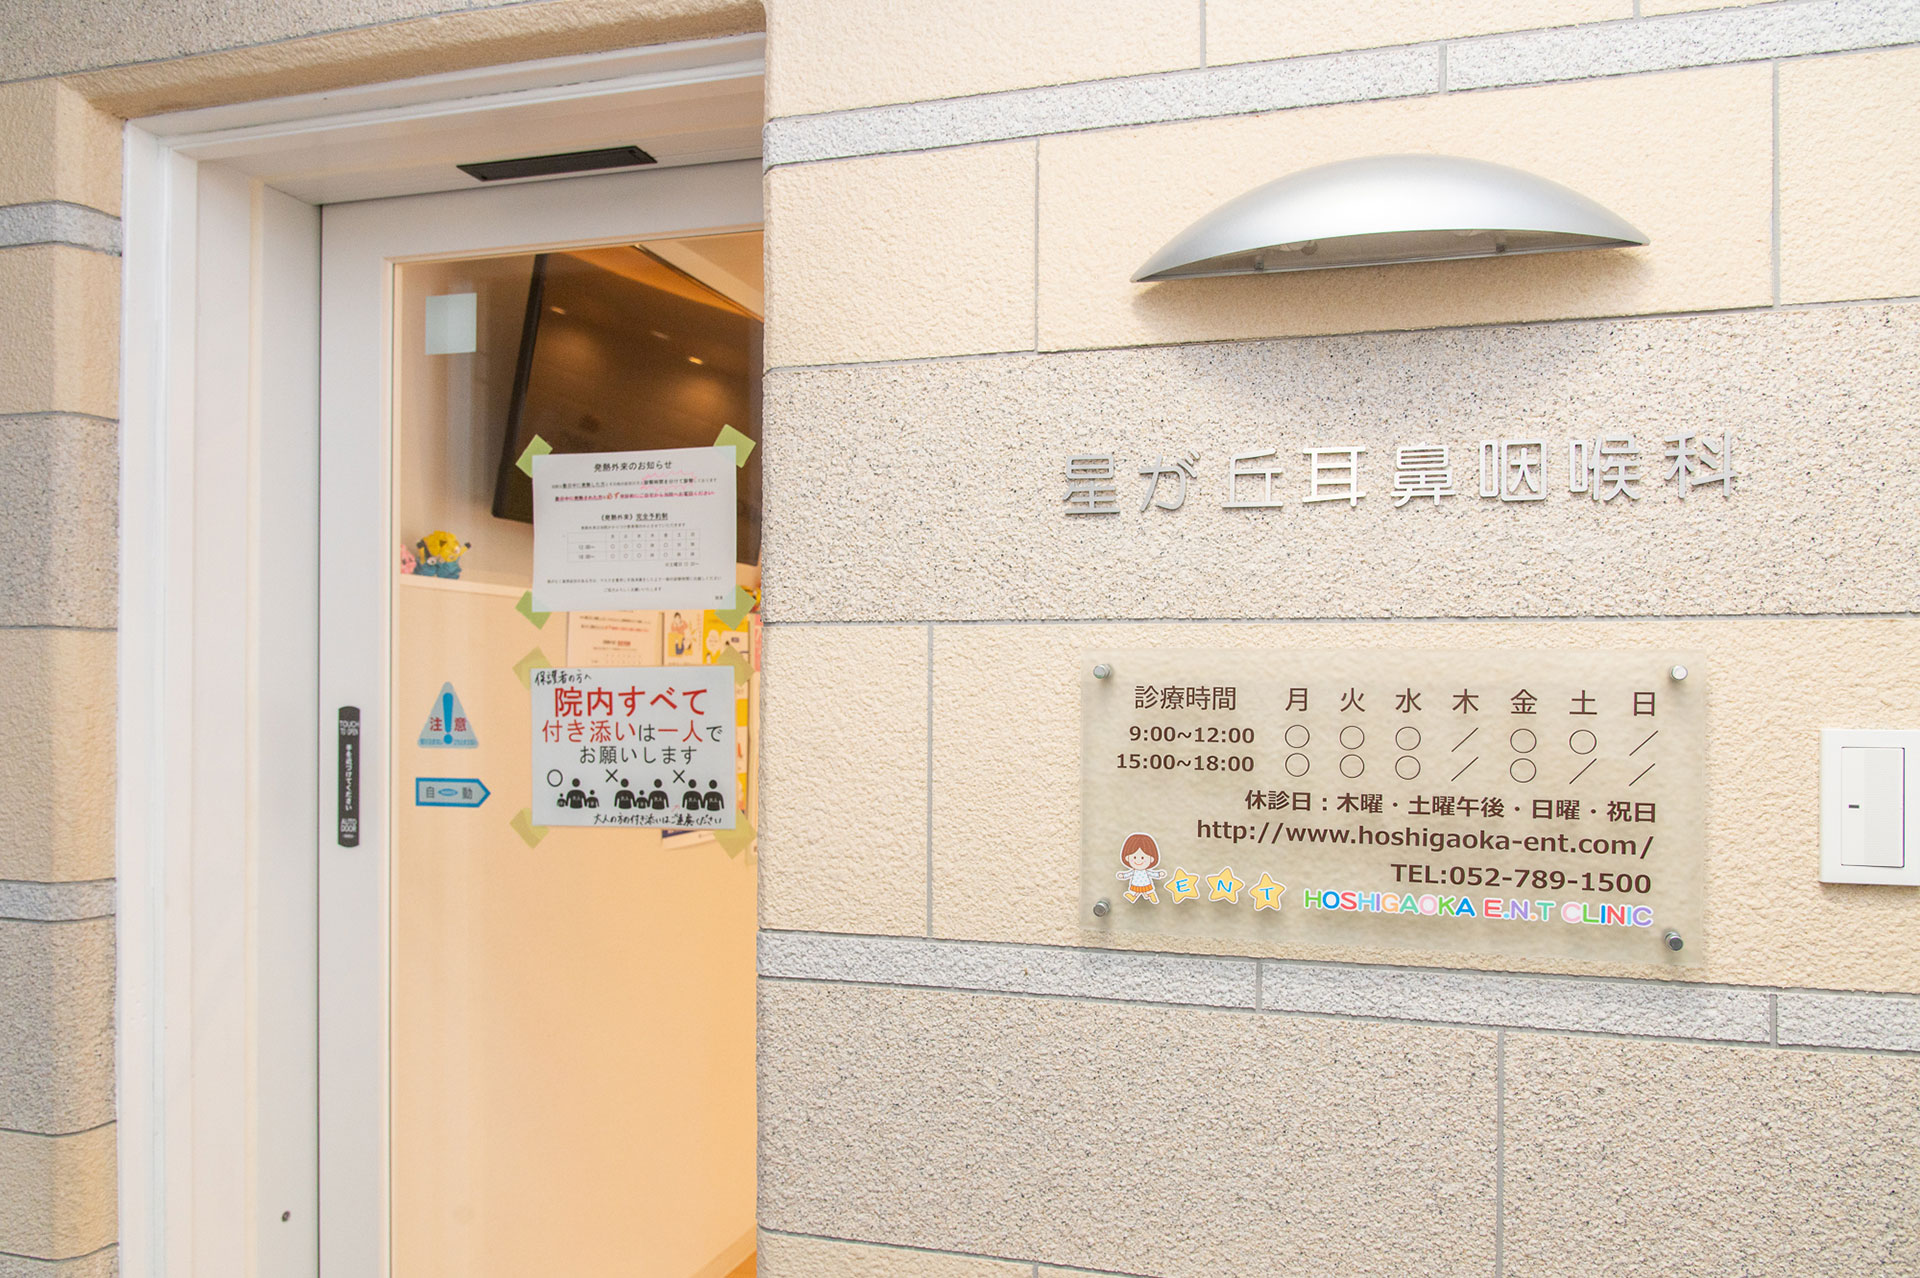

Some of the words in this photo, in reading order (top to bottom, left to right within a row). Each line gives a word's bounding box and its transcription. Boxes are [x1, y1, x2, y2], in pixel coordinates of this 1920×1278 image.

[593, 460, 672, 472] 発熱外来のお知らせ
[1063, 430, 1739, 515] 星が丘耳鼻咽喉科
[534, 670, 591, 686] 保護者の方へ
[555, 686, 708, 718] 院内すべて
[1135, 685, 1237, 711] 診療時間
[1285, 687, 1308, 712] 月
[1340, 688, 1365, 713] 火
[1395, 688, 1422, 713] 水
[1452, 688, 1479, 714] 木
[1510, 689, 1538, 715] 金
[1569, 690, 1597, 715] 土
[1633, 691, 1655, 716] 日
[542, 719, 723, 743] 付き添いは一人で
[579, 745, 698, 765] お願いします
[1197, 819, 1654, 859] http://www.hoshigaoka-ent.com/
[1390, 863, 1651, 893] TEL:052-789-1500
[1304, 889, 1475, 917] HOSHIGAOKA
[1484, 899, 1555, 921] E.N.T
[1562, 902, 1653, 926] CLINIC
